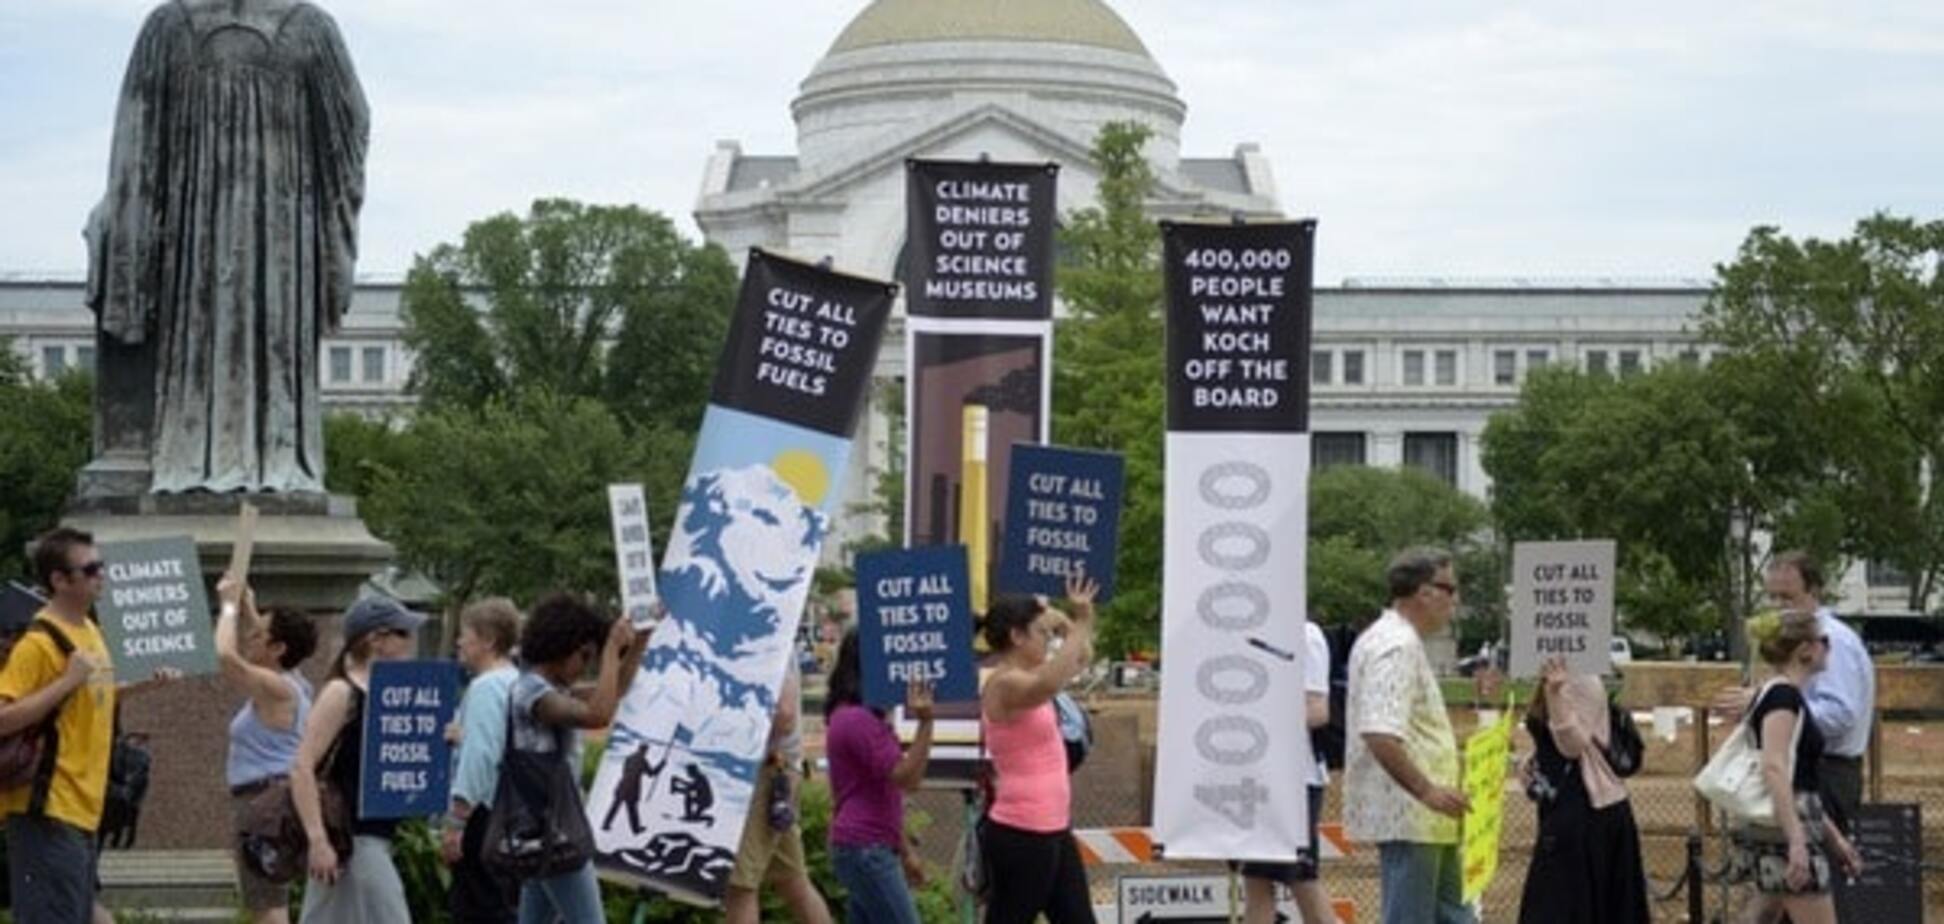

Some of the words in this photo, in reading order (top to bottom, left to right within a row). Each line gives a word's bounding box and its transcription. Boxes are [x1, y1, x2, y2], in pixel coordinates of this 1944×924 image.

[936, 180, 1030, 202] CLIMATE
[936, 204, 1030, 226] DENIERS
[940, 230, 987, 250] OUT
[994, 232, 1025, 250] OF
[936, 255, 1027, 276] SCIENCE
[1184, 249, 1291, 271] 400,000
[926, 280, 1037, 300] MUSEUMS
[1191, 276, 1284, 296] PEOPLE
[768, 287, 814, 313] CUT
[816, 301, 857, 326] ALL
[1200, 304, 1273, 324] WANT
[765, 311, 812, 340] TIES
[819, 326, 849, 349] TO
[1204, 332, 1269, 352] KOCH
[760, 336, 836, 373] FOSSIL
[757, 362, 827, 396] FUELS
[1185, 359, 1232, 379] OFF
[1240, 359, 1288, 380] THE
[1193, 386, 1279, 407] BOARD
[1029, 472, 1068, 495] CUT
[1069, 477, 1104, 500] ALL
[1028, 499, 1068, 523] TIES
[1072, 505, 1097, 526] TO
[1027, 526, 1091, 552] FOSSIL
[109, 559, 184, 582] CLIMATE
[1533, 564, 1566, 582] CUT
[1569, 564, 1600, 581] ALL
[111, 583, 190, 607] DENIERS
[876, 575, 915, 599] CUT
[917, 573, 954, 596] ALL
[1533, 588, 1569, 605] TIES
[1572, 587, 1596, 605] TO
[122, 611, 159, 631] OUT
[164, 608, 188, 627] OF
[878, 605, 920, 627] TIES
[923, 602, 950, 622] TO
[1534, 612, 1590, 630] FOSSIL
[122, 632, 197, 657] SCIENCE
[883, 631, 948, 655] FOSSIL
[1536, 635, 1587, 654] FUELS
[888, 658, 947, 684] FUELS
[381, 686, 413, 708] CUT
[413, 686, 443, 708] ALL
[380, 714, 413, 735] TIES
[415, 714, 437, 735] TO
[379, 742, 432, 764] FOSSIL
[381, 770, 429, 793] FUELS
[1127, 886, 1215, 905] SIDEWALK
